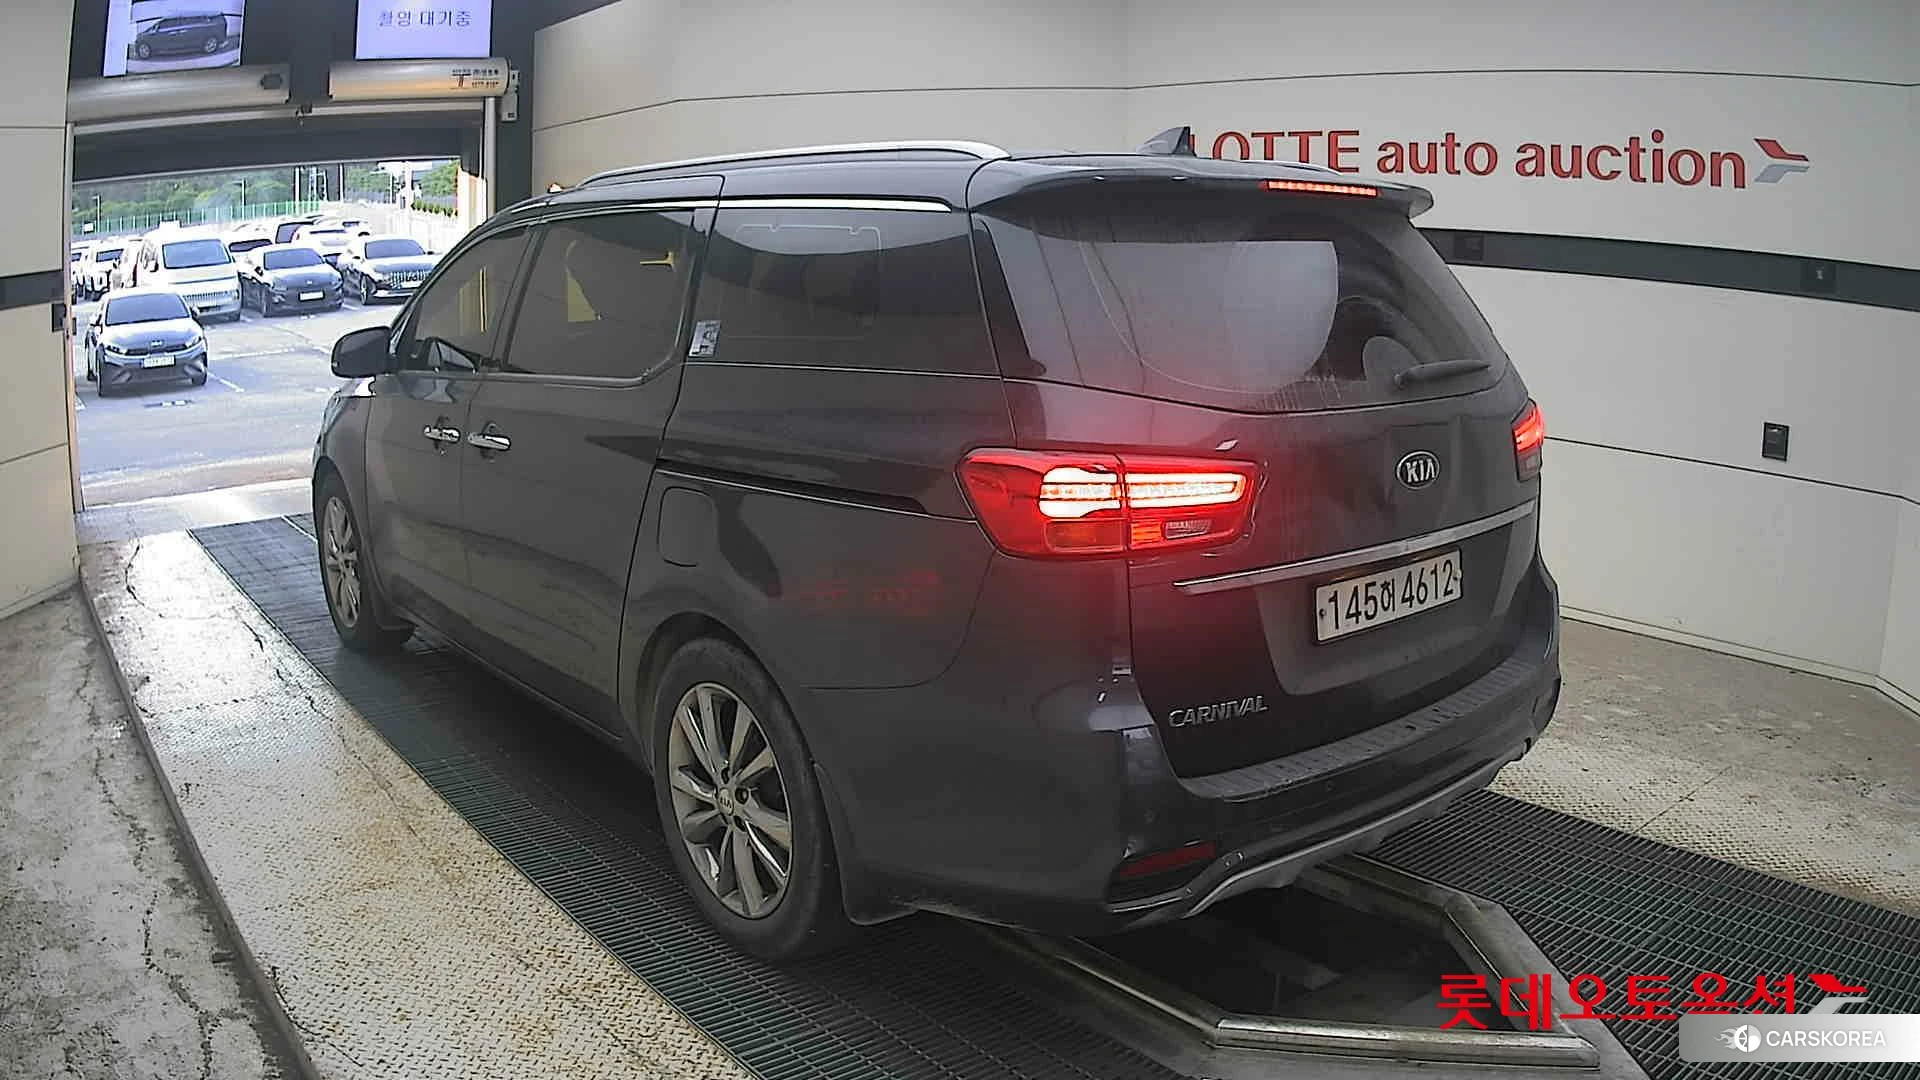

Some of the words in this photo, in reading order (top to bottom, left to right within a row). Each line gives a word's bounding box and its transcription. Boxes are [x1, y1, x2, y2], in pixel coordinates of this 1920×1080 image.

[420, 9, 473, 28] 대기중
[1189, 128, 1361, 174] OTTE
[1376, 131, 1499, 176] auto
[1514, 128, 1747, 189] auction
[1405, 458, 1436, 483] KIA
[1168, 695, 1269, 728] CARNIVAL
